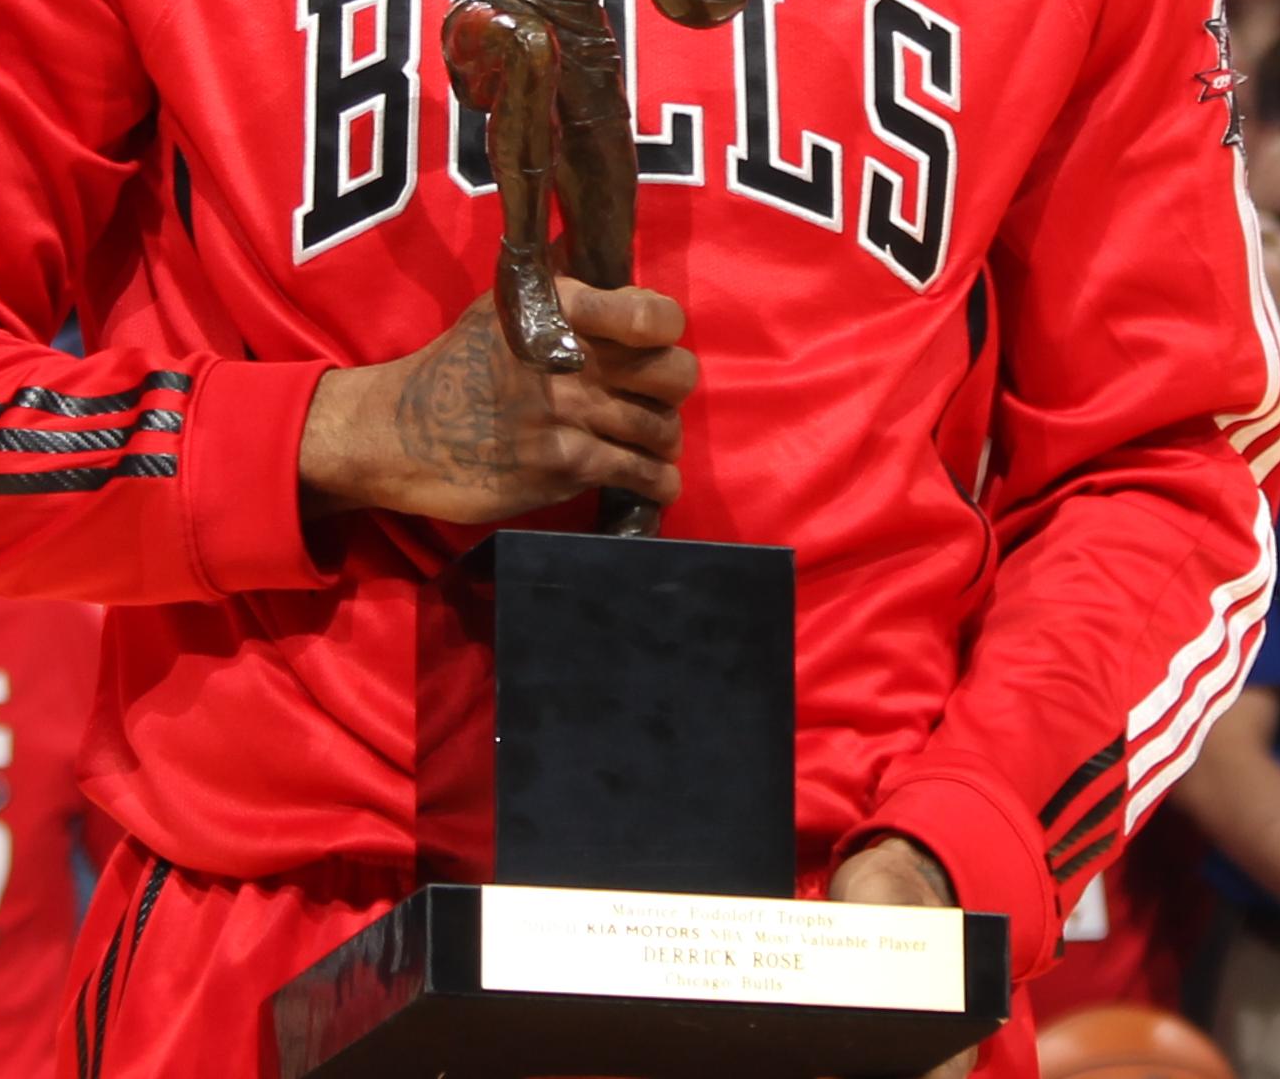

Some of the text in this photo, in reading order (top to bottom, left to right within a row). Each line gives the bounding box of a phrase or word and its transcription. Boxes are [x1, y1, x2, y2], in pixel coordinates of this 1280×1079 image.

[612, 903, 835, 929] Maurice Podoloff Trophy
[586, 922, 618, 936] KIA
[625, 924, 701, 940] MOTORS
[754, 930, 790, 944] Most
[800, 931, 869, 950] Valuable
[878, 935, 928, 954] Player
[642, 945, 806, 971] DERRICK ROSE
[664, 970, 784, 992] Chicago Bulls
